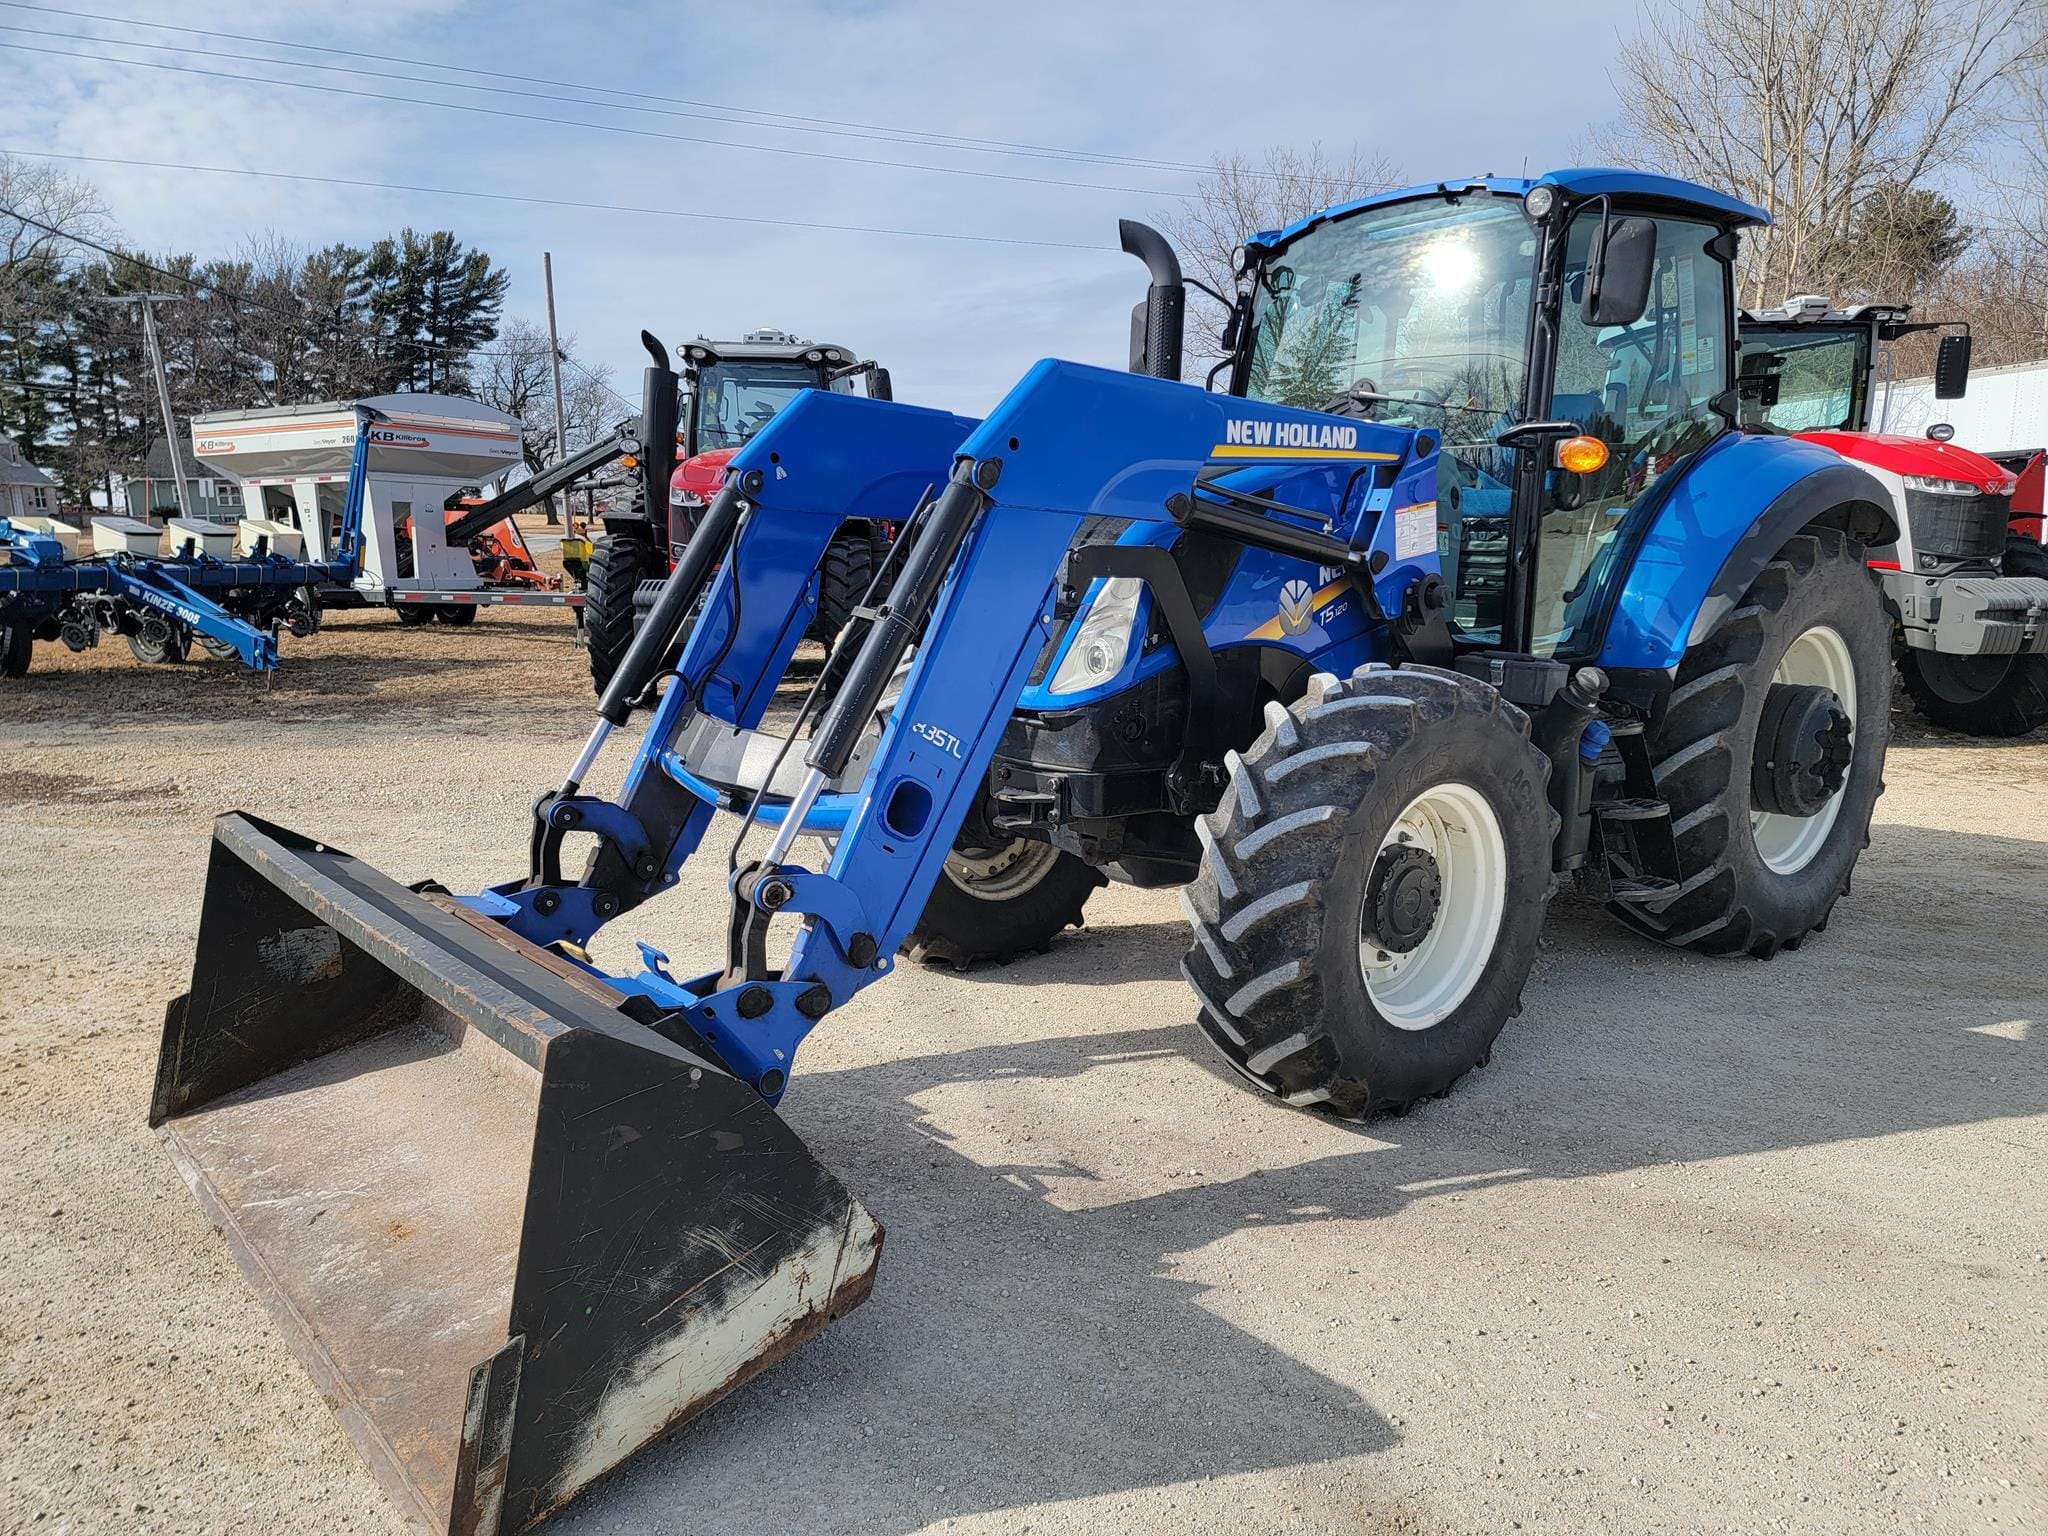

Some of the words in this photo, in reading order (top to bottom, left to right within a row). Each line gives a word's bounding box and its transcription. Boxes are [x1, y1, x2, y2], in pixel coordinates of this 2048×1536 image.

[200, 440, 214, 450] KB
[370, 430, 394, 442] KB
[1226, 419, 1273, 445] NEW
[1275, 422, 1358, 449] HOLLAND
[1319, 564, 1346, 586] NE
[142, 590, 176, 613] KINZE
[175, 606, 201, 625] 3005
